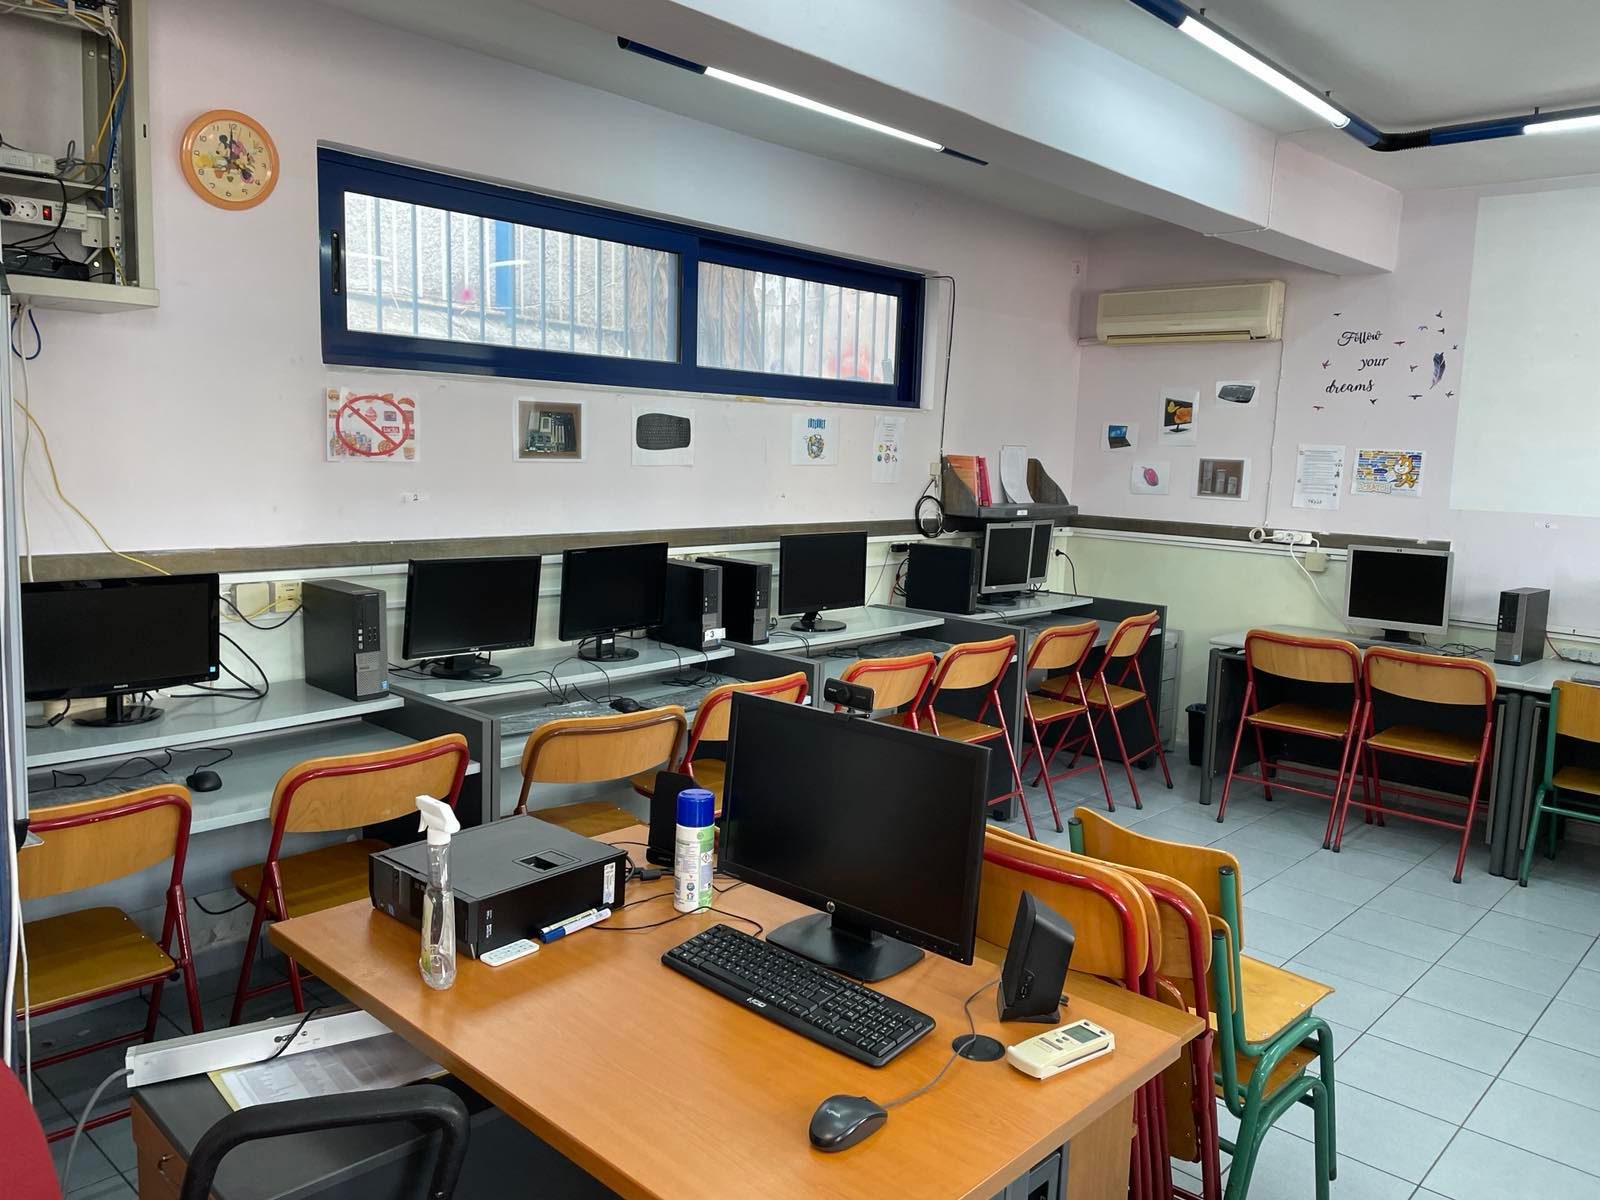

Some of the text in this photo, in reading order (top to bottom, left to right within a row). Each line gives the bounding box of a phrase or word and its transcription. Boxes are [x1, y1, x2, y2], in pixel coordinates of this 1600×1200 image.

[1337, 331, 1383, 347] Follow
[1357, 356, 1389, 371] your
[1325, 379, 1375, 394] dreams
[709, 630, 715, 638] 3
